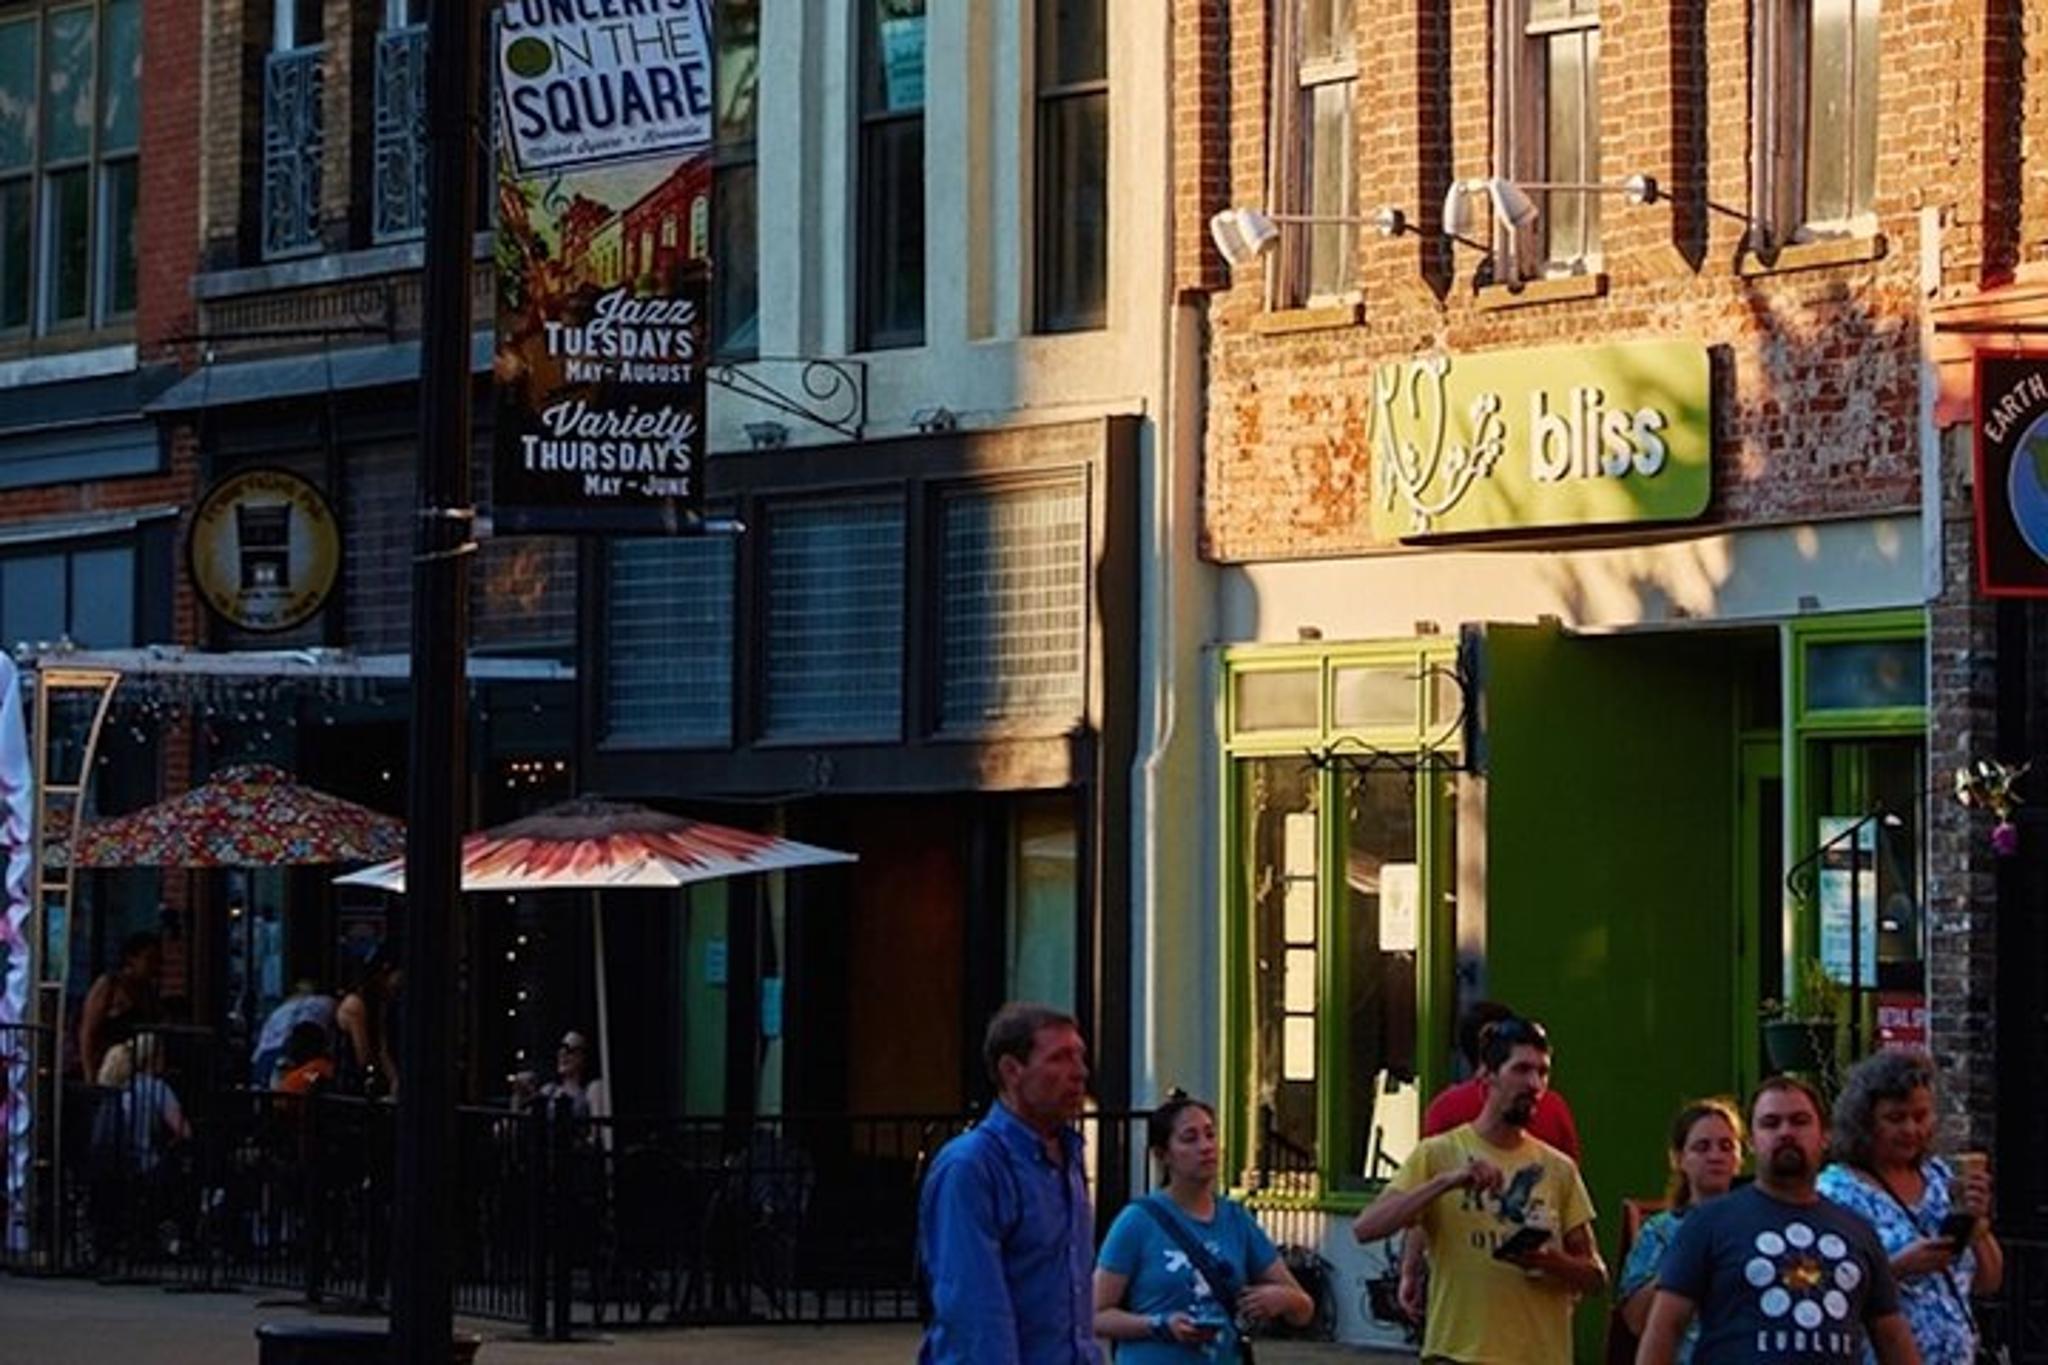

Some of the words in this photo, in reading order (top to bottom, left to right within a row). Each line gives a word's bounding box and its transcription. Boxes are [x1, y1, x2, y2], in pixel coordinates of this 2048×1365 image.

[506, 29, 592, 78] ON
[597, 16, 699, 66] THE
[512, 62, 711, 140] SQUARE
[544, 320, 694, 358] TUESDAYS
[588, 287, 696, 336] Jazz
[542, 400, 698, 450] Variety
[1530, 387, 1666, 482] bliss
[1984, 372, 2048, 443] EARTH
[520, 434, 692, 472] THURSDAYS
